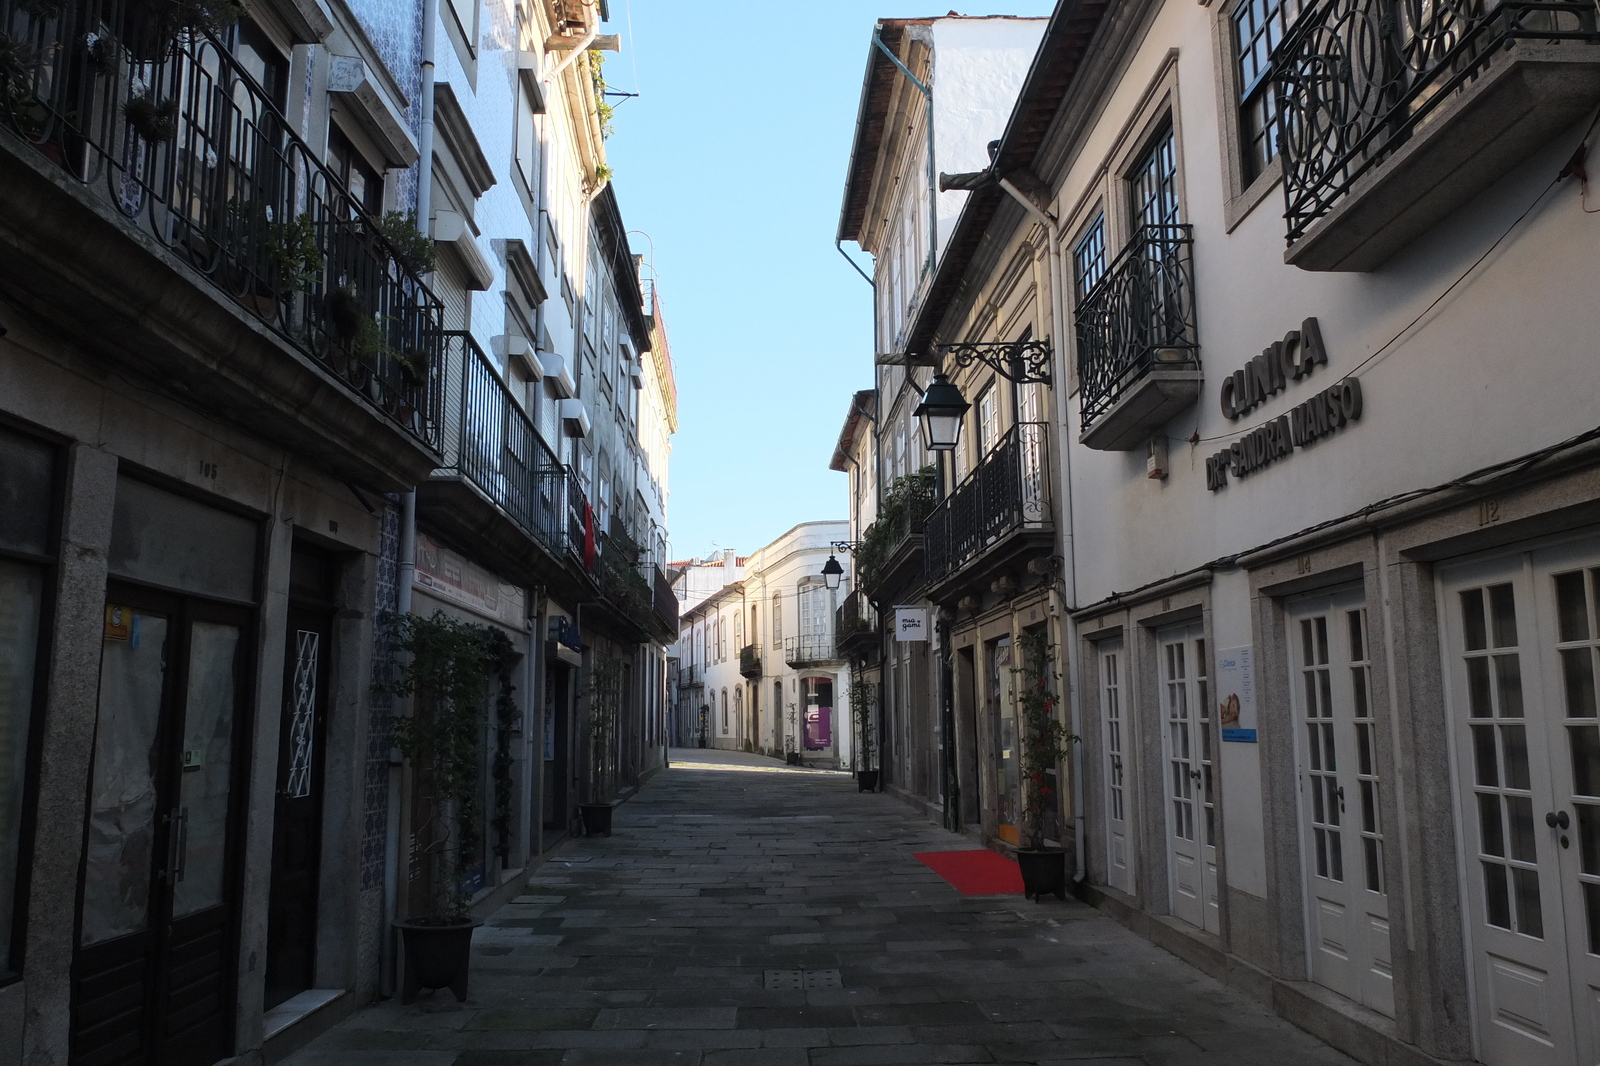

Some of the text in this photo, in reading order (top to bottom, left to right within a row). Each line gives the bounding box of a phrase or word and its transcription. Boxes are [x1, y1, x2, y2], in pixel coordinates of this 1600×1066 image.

[1221, 316, 1328, 420] CLINICA
[1230, 415, 1294, 478] SANDRA
[1291, 376, 1363, 447] MANSO
[199, 460, 217, 480] 105
[1478, 500, 1500, 527] 112
[1297, 555, 1312, 574] 114
[902, 620, 921, 632] gami
